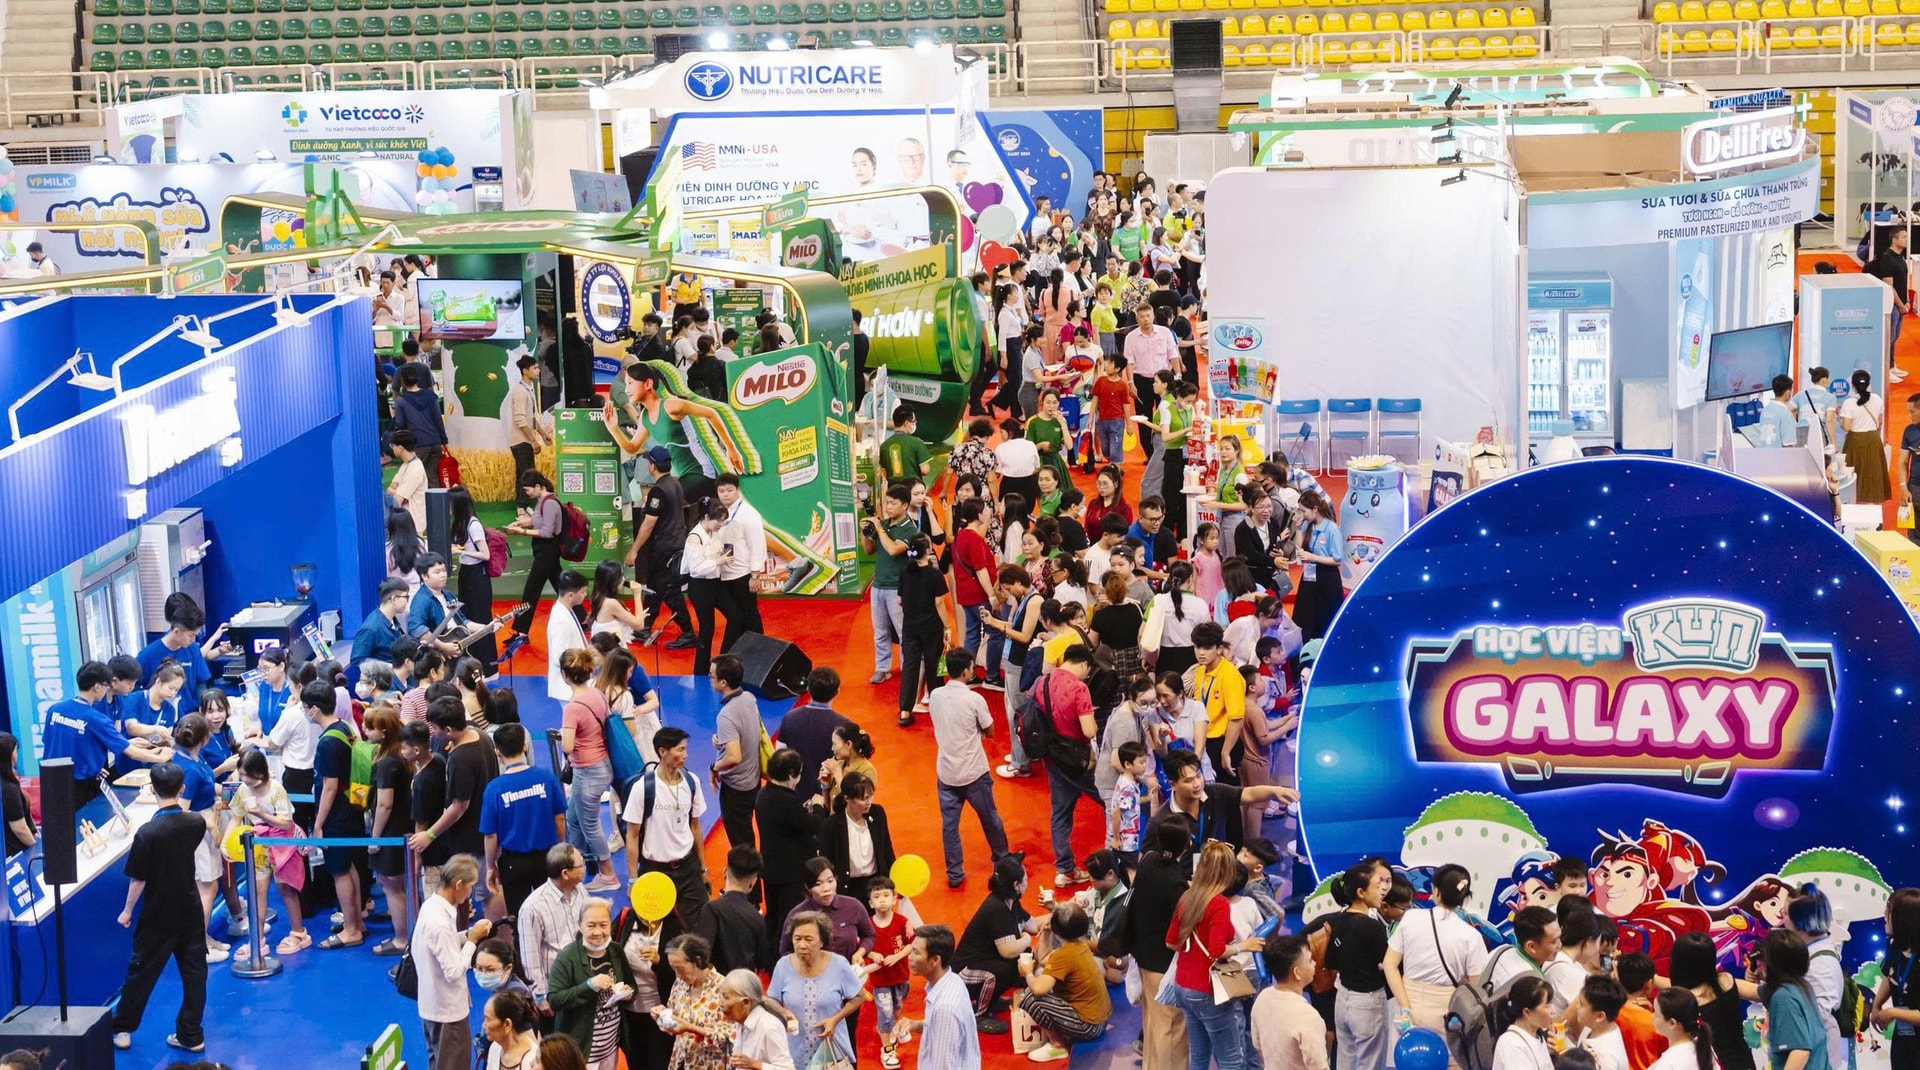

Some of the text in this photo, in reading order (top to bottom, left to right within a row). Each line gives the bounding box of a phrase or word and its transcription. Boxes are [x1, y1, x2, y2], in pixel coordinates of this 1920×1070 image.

[739, 65, 882, 84] NUTRICARE
[1712, 95, 1750, 110] PREMIUM
[319, 104, 402, 121] Vietcoco
[752, 144, 778, 154] USA
[1703, 122, 1793, 163] DeliFres
[29, 174, 74, 187] VPMILK
[705, 182, 732, 192] DINH
[736, 180, 779, 191] DƯỠNG
[783, 182, 790, 190] Y
[1700, 193, 1708, 204] &
[1734, 186, 1760, 200] CHUA
[1762, 182, 1789, 196] THANH
[161, 204, 202, 225] sữa
[1658, 225, 1698, 239] PREMIUM
[1700, 220, 1750, 236] PASTEURIZED
[1752, 216, 1767, 230] MILK
[1768, 216, 1780, 226] AND
[789, 244, 817, 260] MILO
[864, 275, 885, 293] MINH
[885, 270, 912, 288] KHOA
[913, 262, 938, 284] HỌC
[777, 360, 806, 372] Nestlé
[744, 369, 806, 398] MILO
[778, 428, 797, 442] NAY
[782, 448, 800, 458] KHOA
[1475, 608, 1760, 666] HỌC VIỆN KUN
[50, 712, 88, 731] Vinamilk
[1452, 676, 1795, 750] GALAXY
[501, 783, 546, 804] Vinamilk
